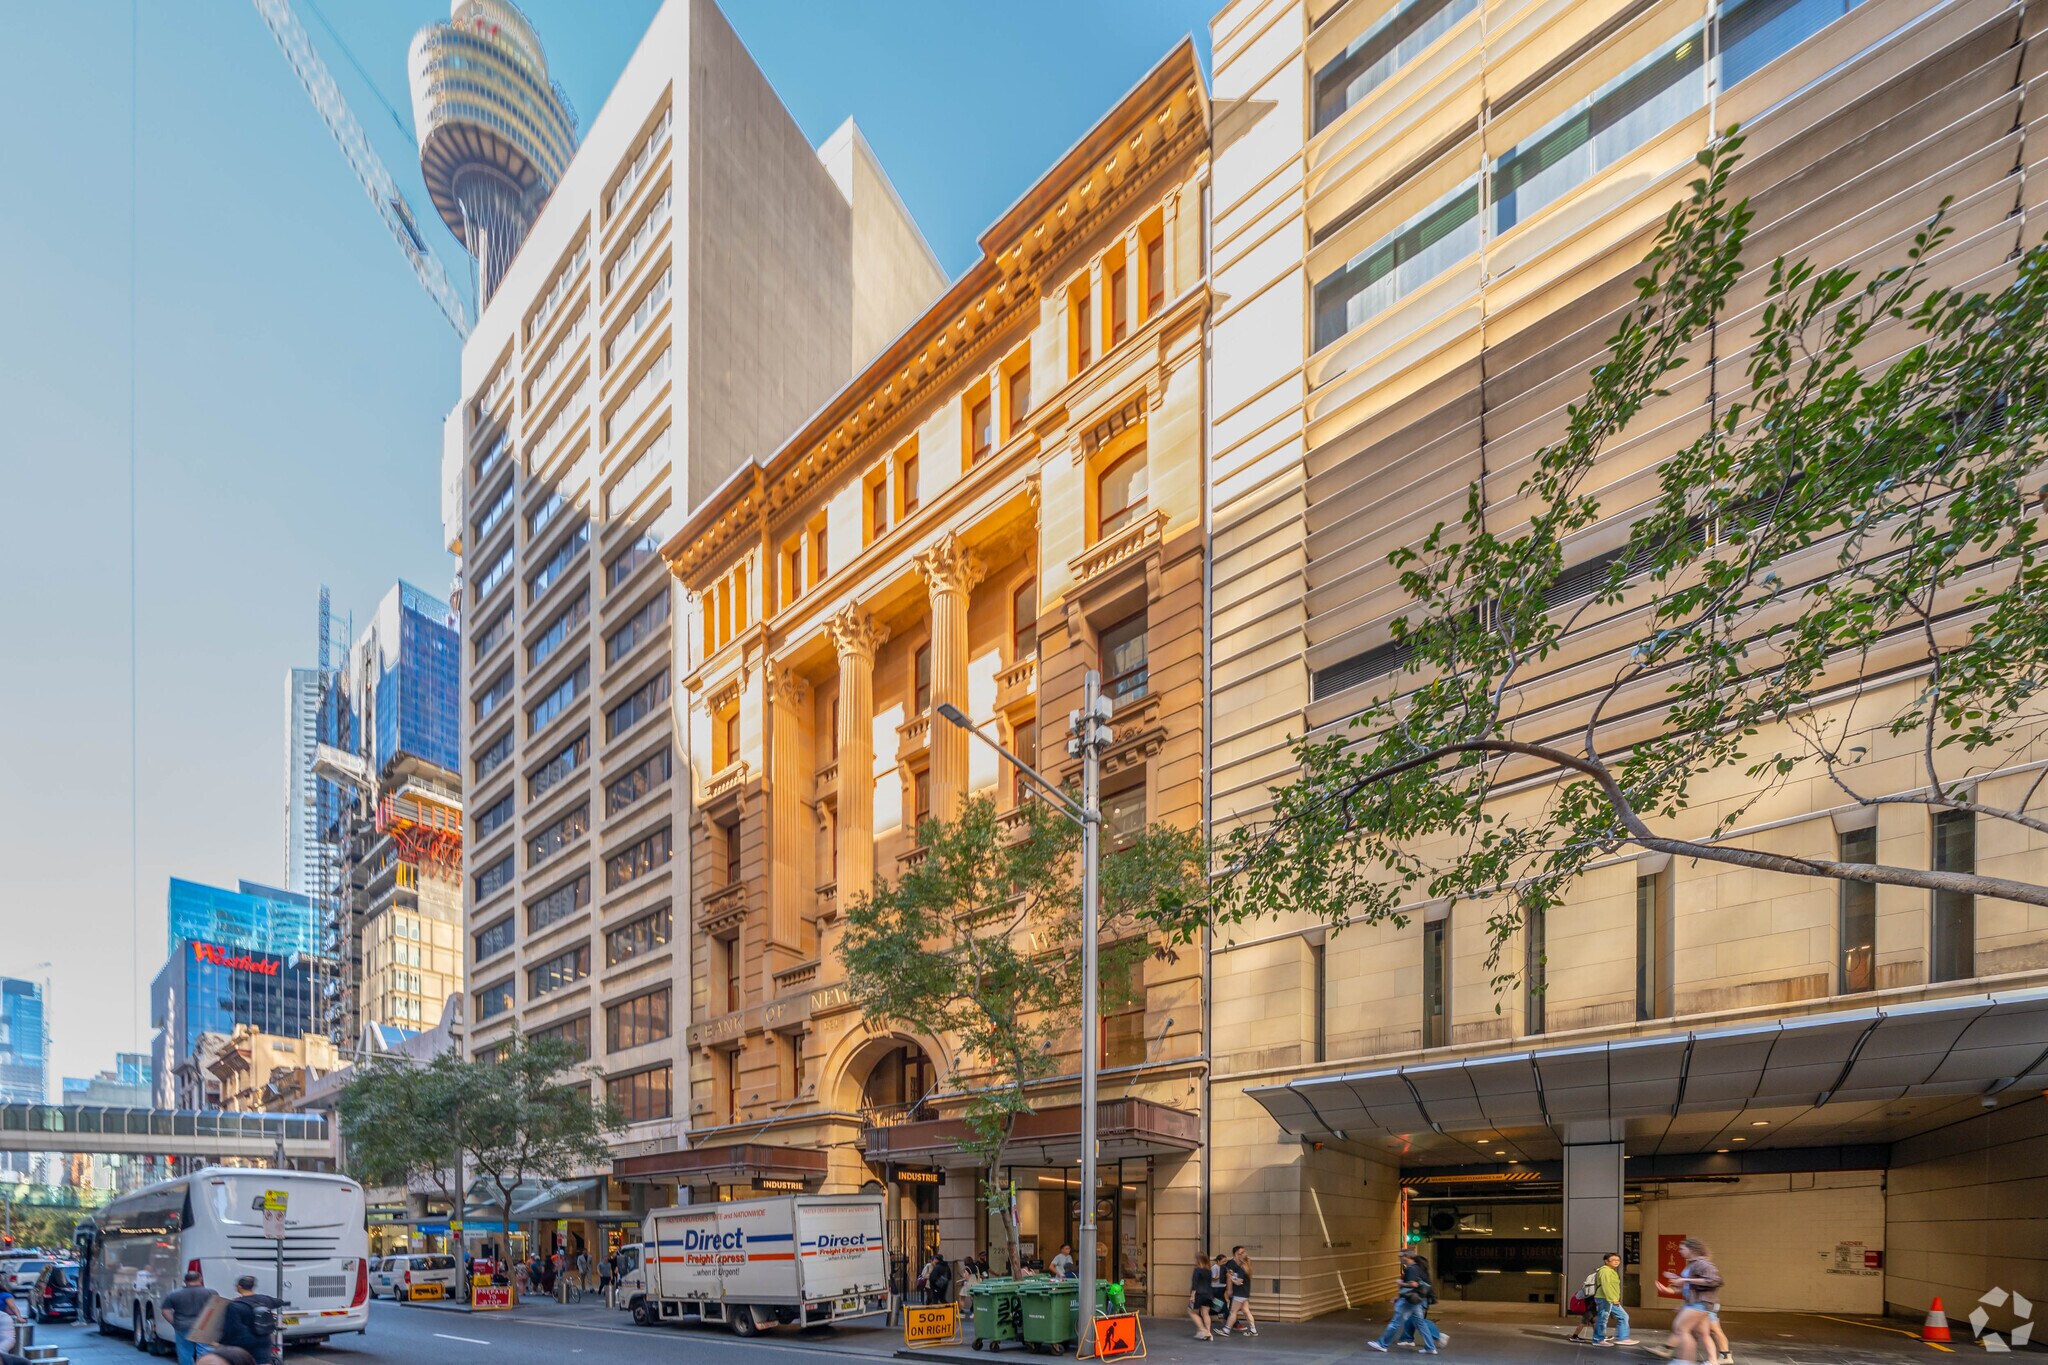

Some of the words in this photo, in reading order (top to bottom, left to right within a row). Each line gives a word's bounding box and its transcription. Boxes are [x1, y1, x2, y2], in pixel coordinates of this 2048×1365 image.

[192, 941, 280, 976] Westfield
[704, 1014, 744, 1038] BANK
[764, 1003, 786, 1023] OF
[898, 1171, 938, 1182] INDUSTRIE
[763, 1180, 803, 1190] INDUSTRIE
[733, 1209, 766, 1219] NATIONWIDE
[685, 1227, 744, 1250] Direct
[818, 1233, 865, 1248] Direct
[819, 1248, 841, 1256] Freight
[841, 1247, 865, 1255] Express
[687, 1253, 714, 1266] Freight
[919, 1313, 945, 1323] 50m
[911, 1326, 924, 1337] ON
[926, 1323, 952, 1336] RIGHT
